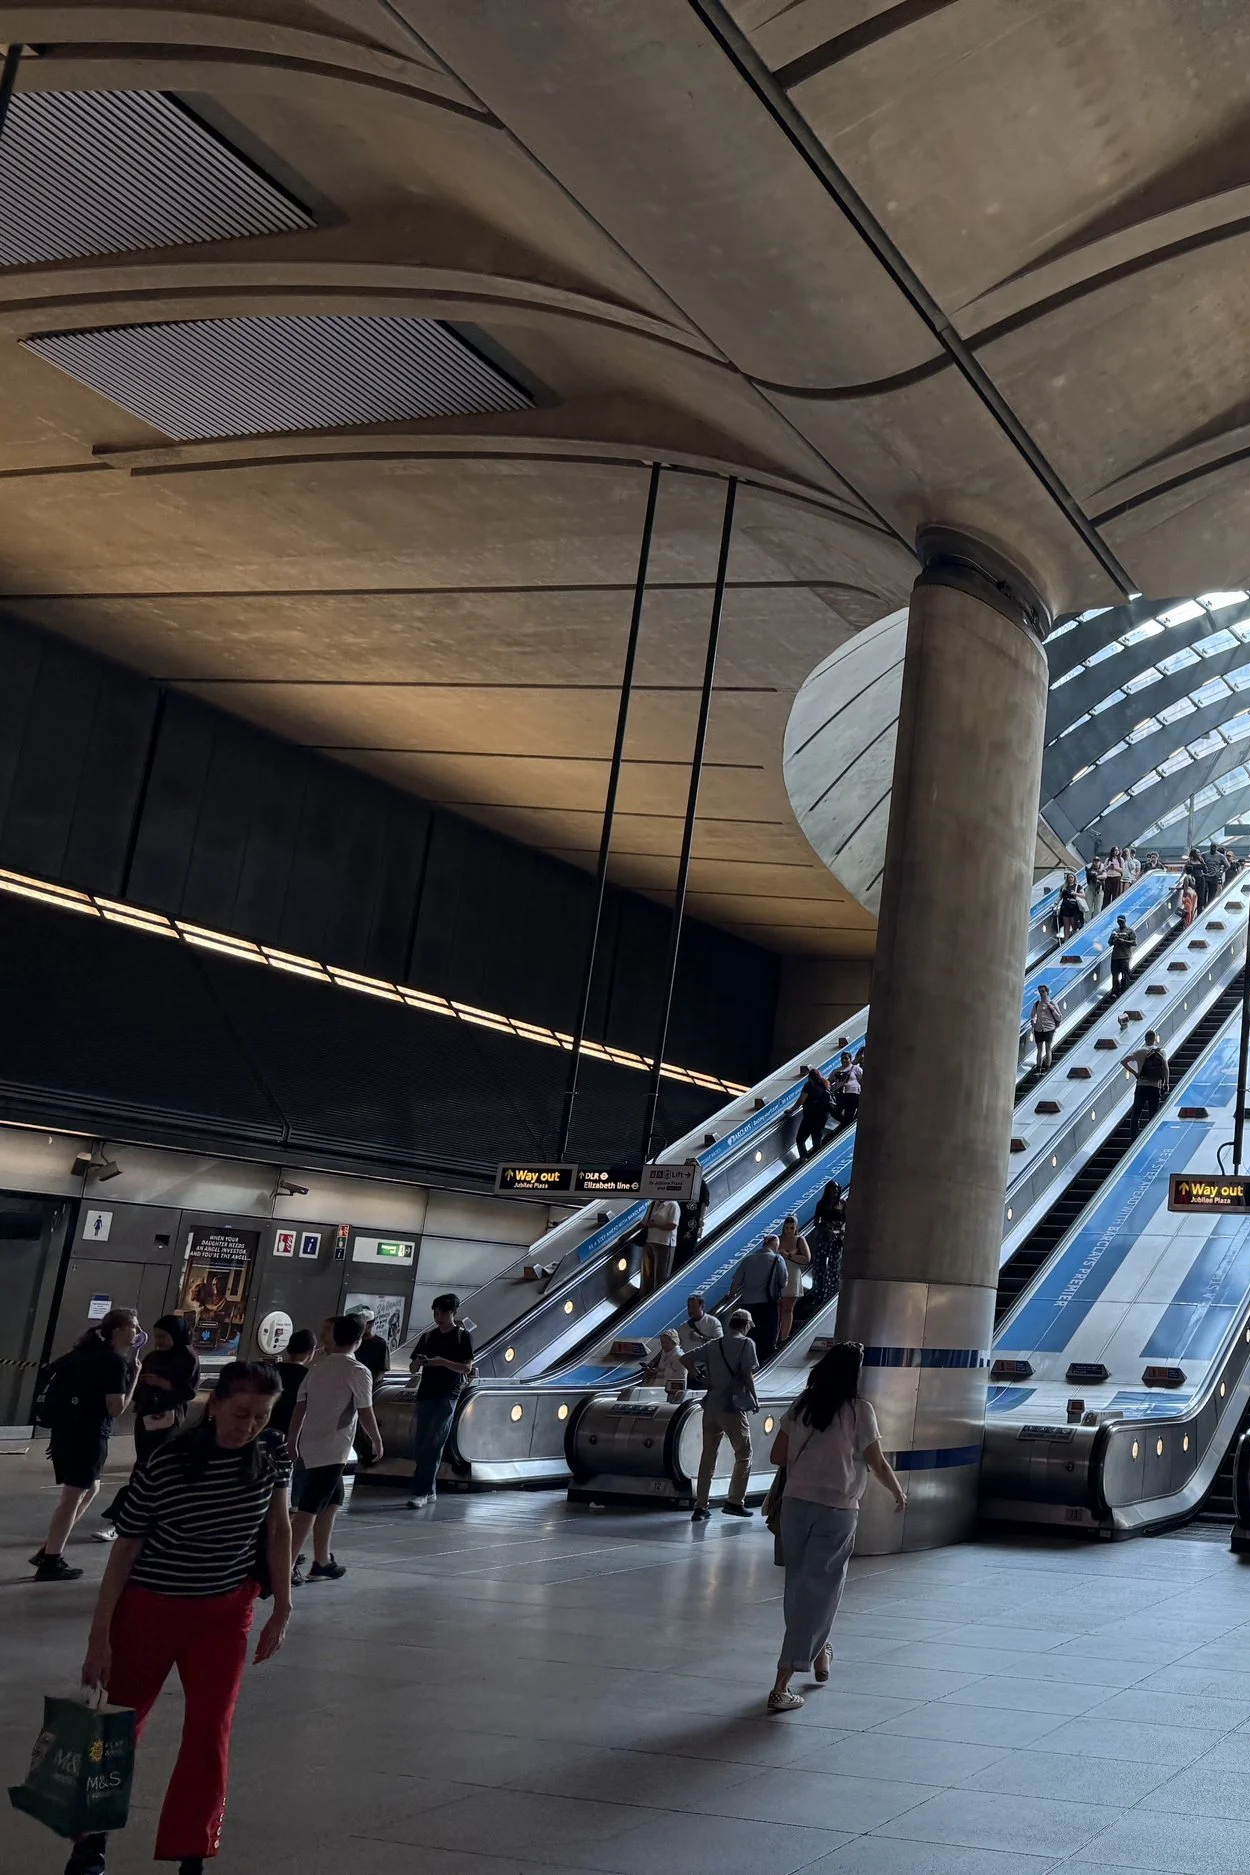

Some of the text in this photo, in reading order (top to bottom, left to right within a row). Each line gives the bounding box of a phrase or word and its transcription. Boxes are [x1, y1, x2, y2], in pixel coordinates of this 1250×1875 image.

[515, 1170, 561, 1183] Way out
[585, 1172, 599, 1180] DLR
[584, 1181, 630, 1190] Elizabeth line
[1127, 1180, 1149, 1205] AHEAD
[1191, 1183, 1243, 1197] Way out
[1190, 1196, 1231, 1205] Jubilee Plaza
[1112, 1204, 1133, 1225] WITH
[1083, 1226, 1120, 1267] BARCLAYS
[1053, 1268, 1090, 1307] PREMIER
[86, 1771, 121, 1792] M&S
